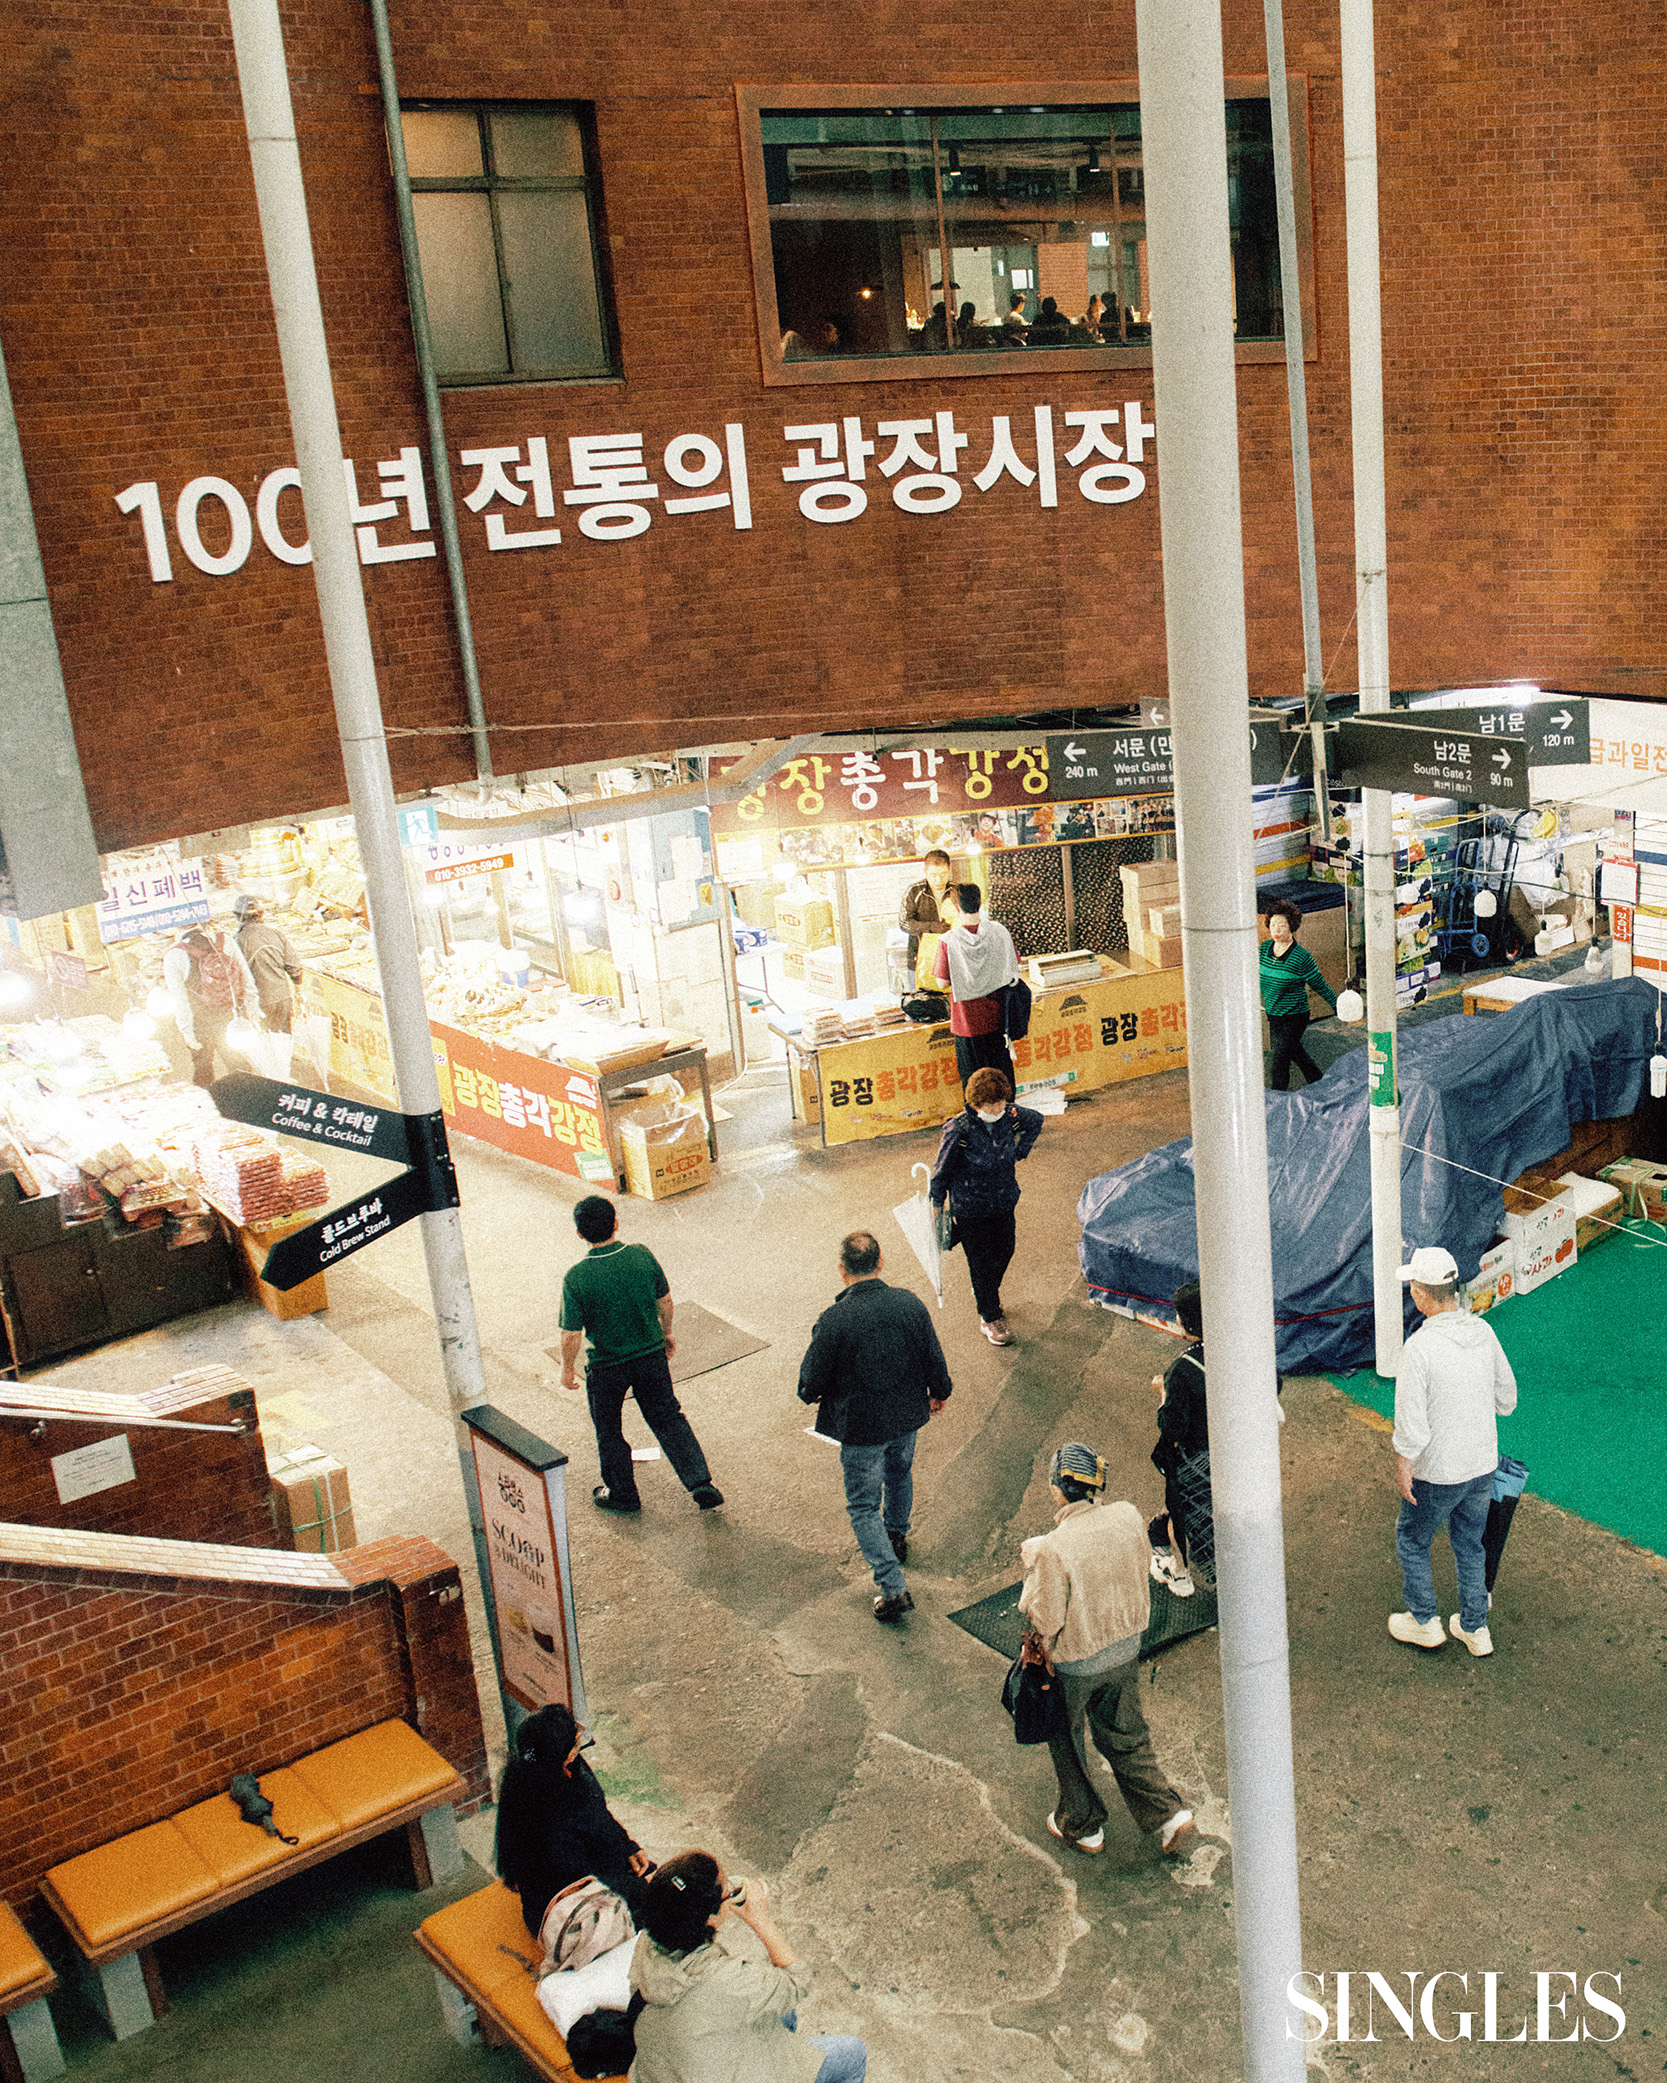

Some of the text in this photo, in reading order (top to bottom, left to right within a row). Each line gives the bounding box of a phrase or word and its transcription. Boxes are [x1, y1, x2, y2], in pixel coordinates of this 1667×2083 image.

[460, 423, 752, 551] 전통의
[782, 402, 1155, 523] 광장시장
[1479, 711, 1526, 734] 남1문
[1113, 737, 1146, 758] 서문
[1433, 740, 1473, 765] 남2문
[1542, 734, 1575, 747] 120 m
[1065, 760, 1166, 779] 240 m West Gate
[1413, 762, 1473, 781] South Gate 2
[1489, 772, 1514, 788] 90 m
[277, 1092, 379, 1133] 커피 & 칵테일
[271, 1111, 373, 1147] Coffee & Cocktail
[320, 1197, 383, 1244] 콜드브루바
[319, 1214, 391, 1263] Cold Brew Stand
